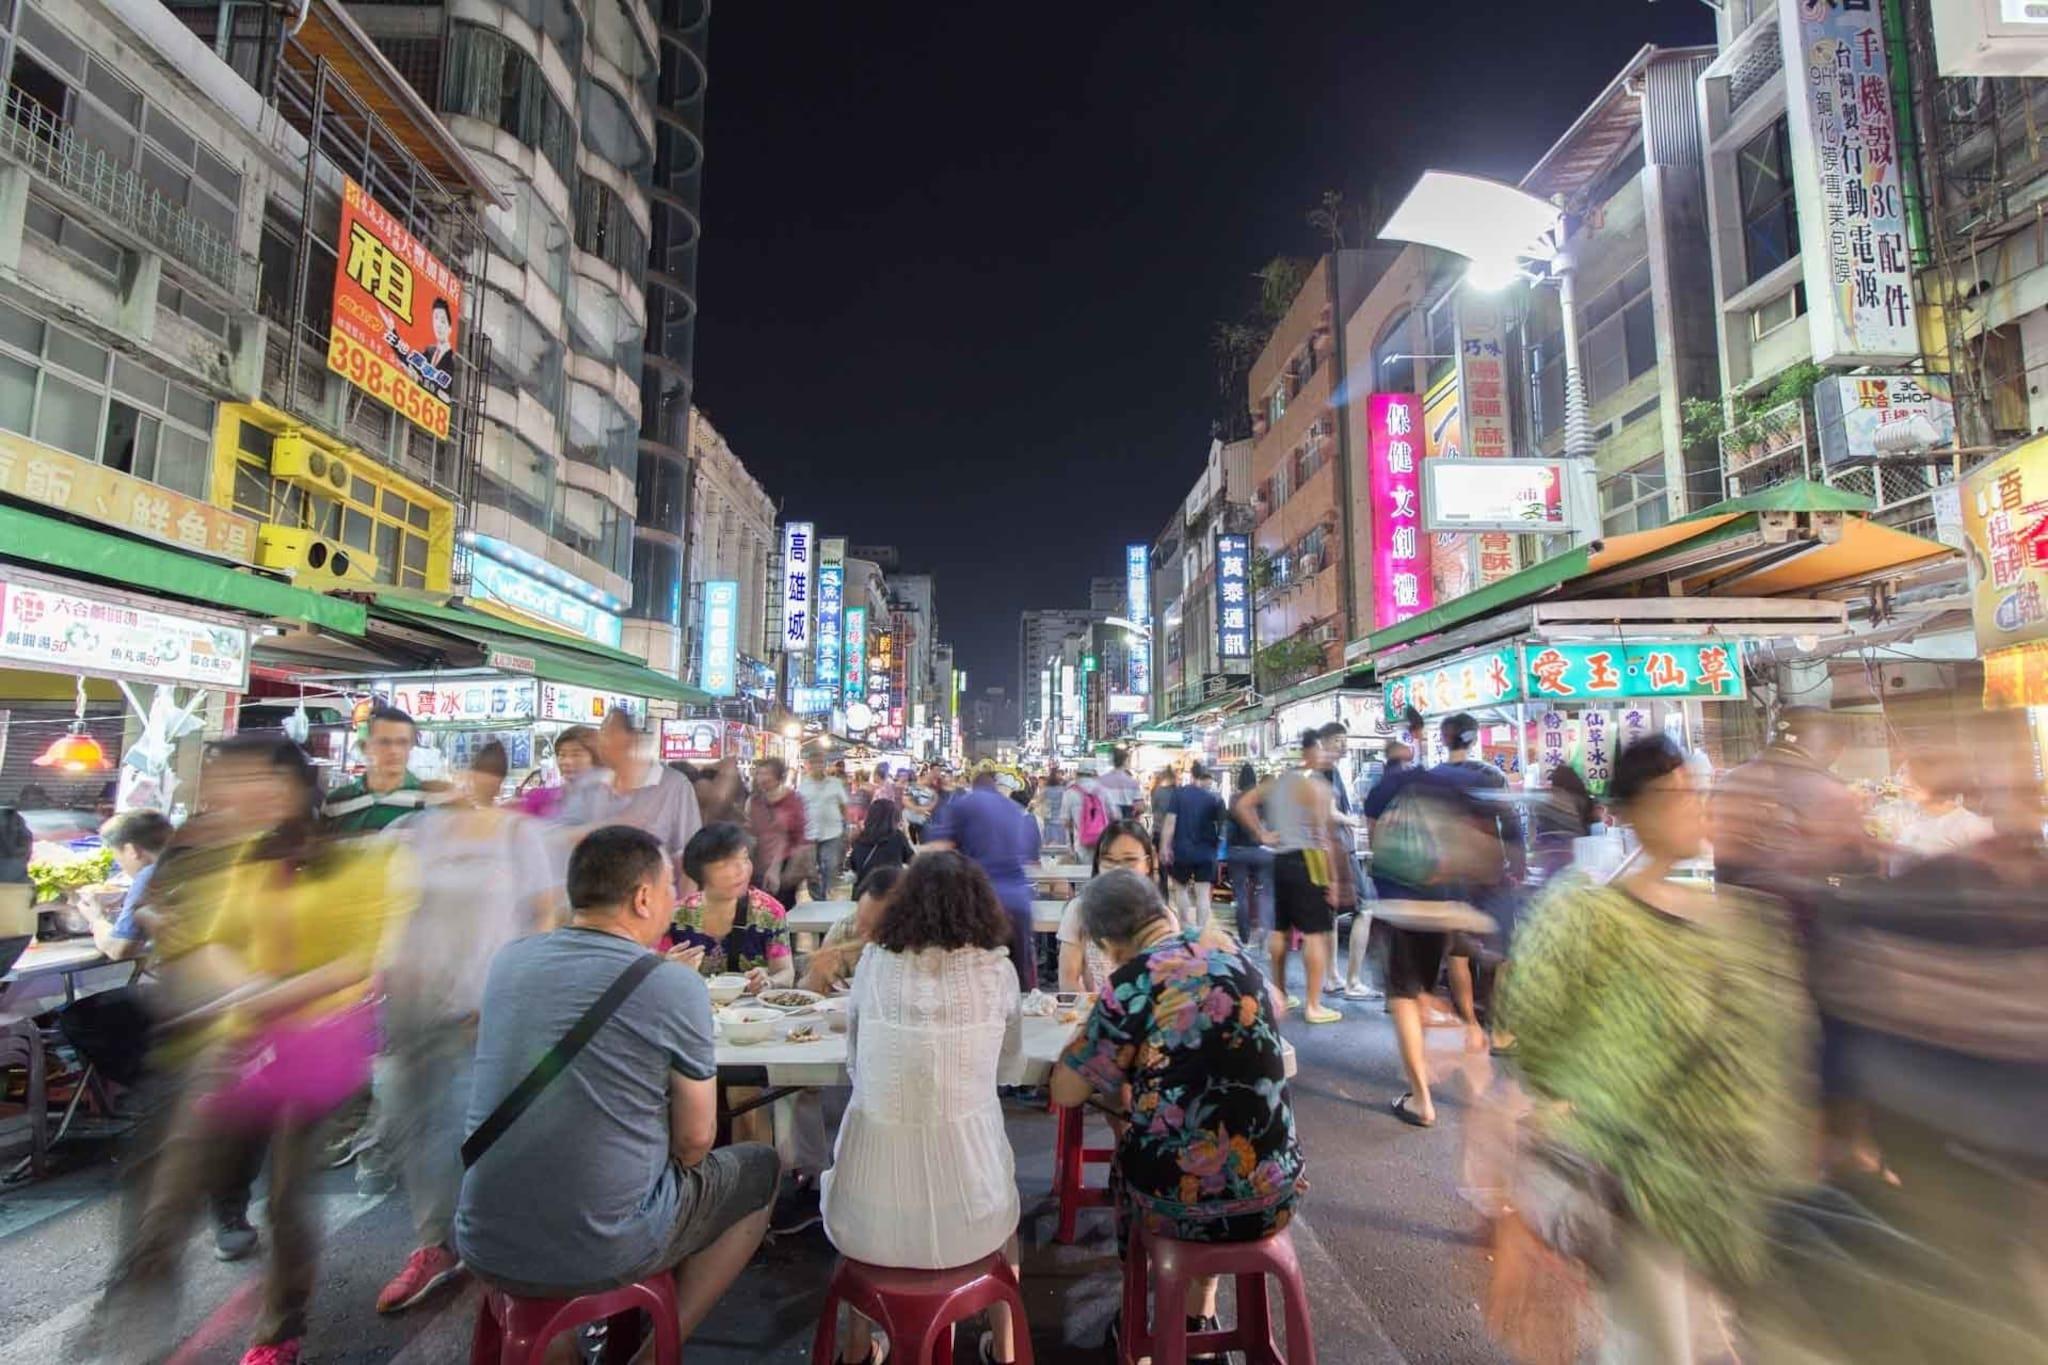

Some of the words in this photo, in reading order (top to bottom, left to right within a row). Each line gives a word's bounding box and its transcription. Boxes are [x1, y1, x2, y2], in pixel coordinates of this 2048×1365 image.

[345, 219, 414, 327] 租
[331, 334, 449, 437] 398-6568
[1892, 392, 1933, 404] SHOP
[787, 532, 808, 641] 高雄城
[1221, 556, 1246, 655] 萬泰通訊
